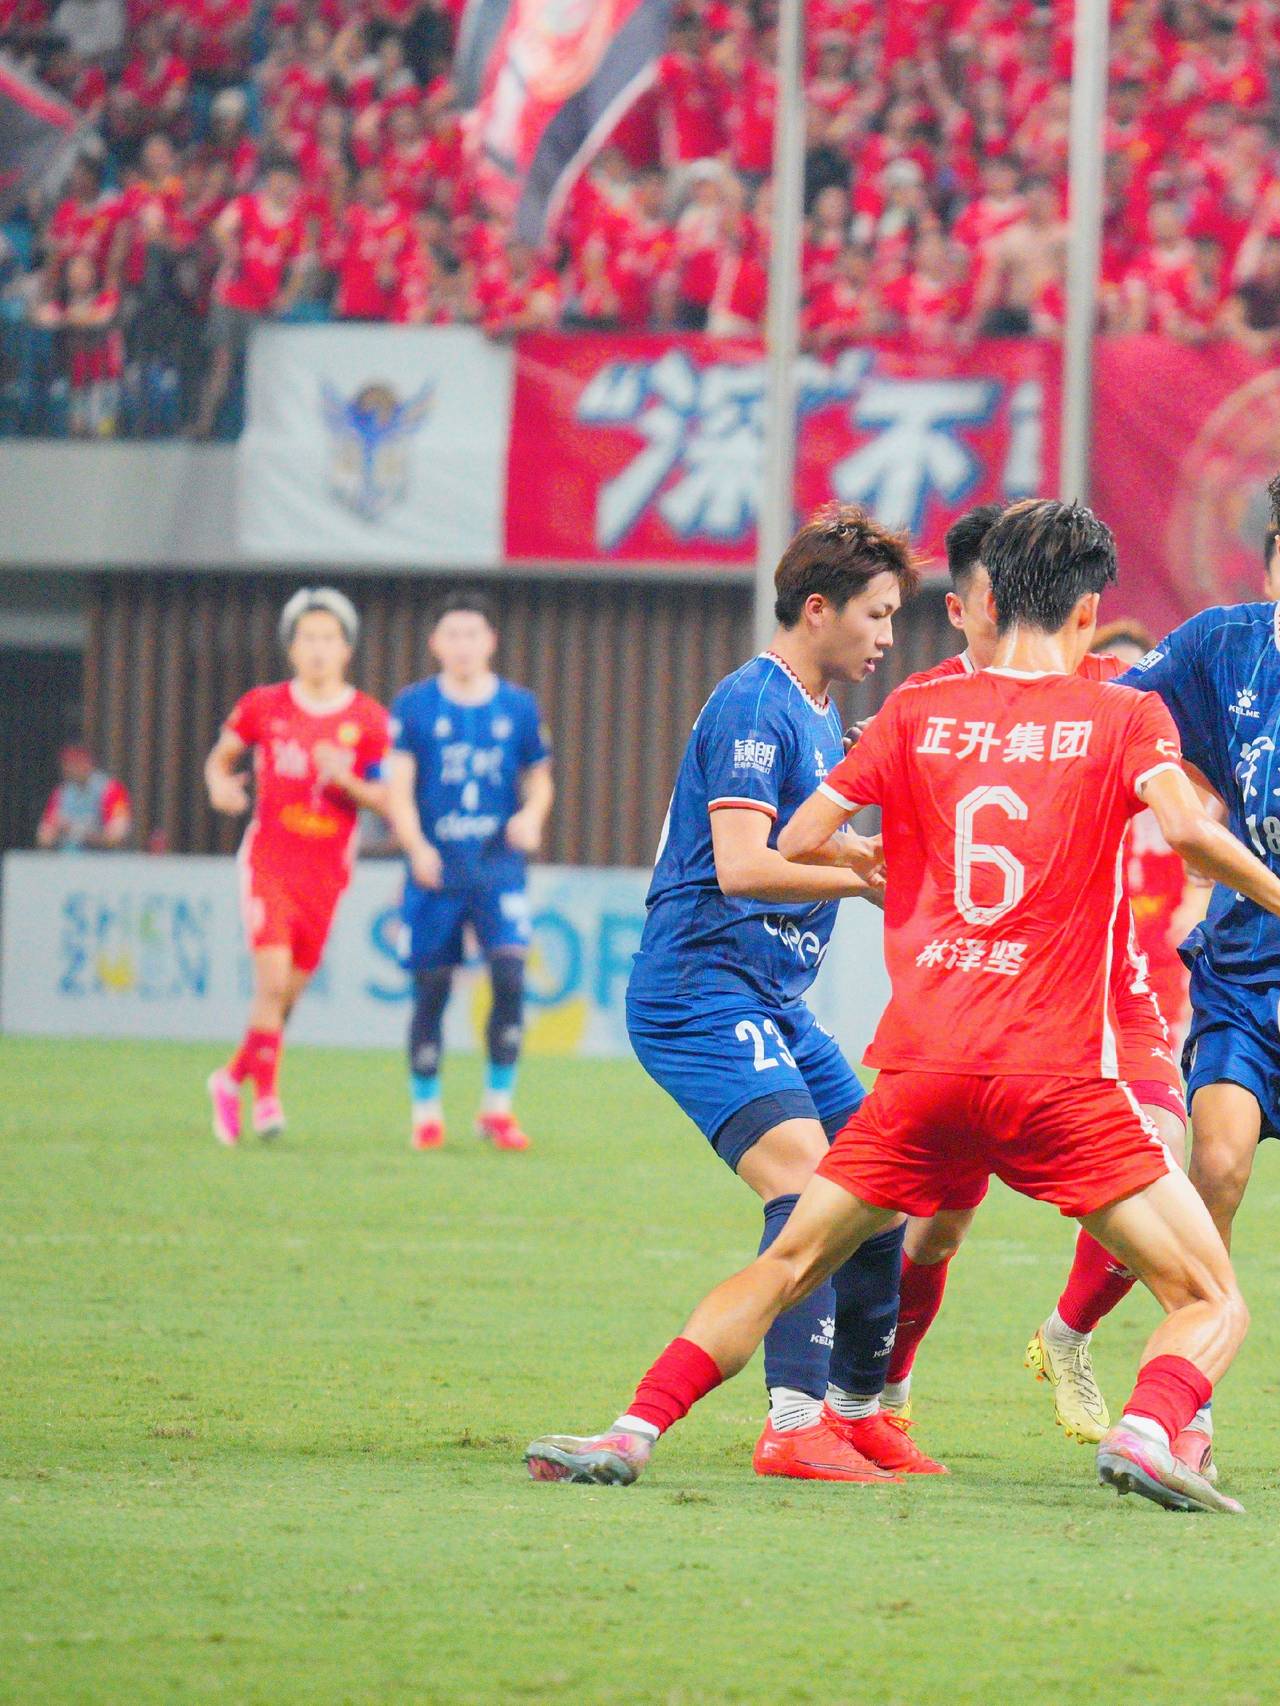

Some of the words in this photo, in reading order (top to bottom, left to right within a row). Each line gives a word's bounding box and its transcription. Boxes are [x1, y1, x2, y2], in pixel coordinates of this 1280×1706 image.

[1229, 704, 1260, 718] KELME
[916, 716, 1093, 763] 正升集团
[954, 786, 1028, 926] 6
[916, 936, 1028, 976] 林泽坚
[735, 1019, 798, 1072] 23
